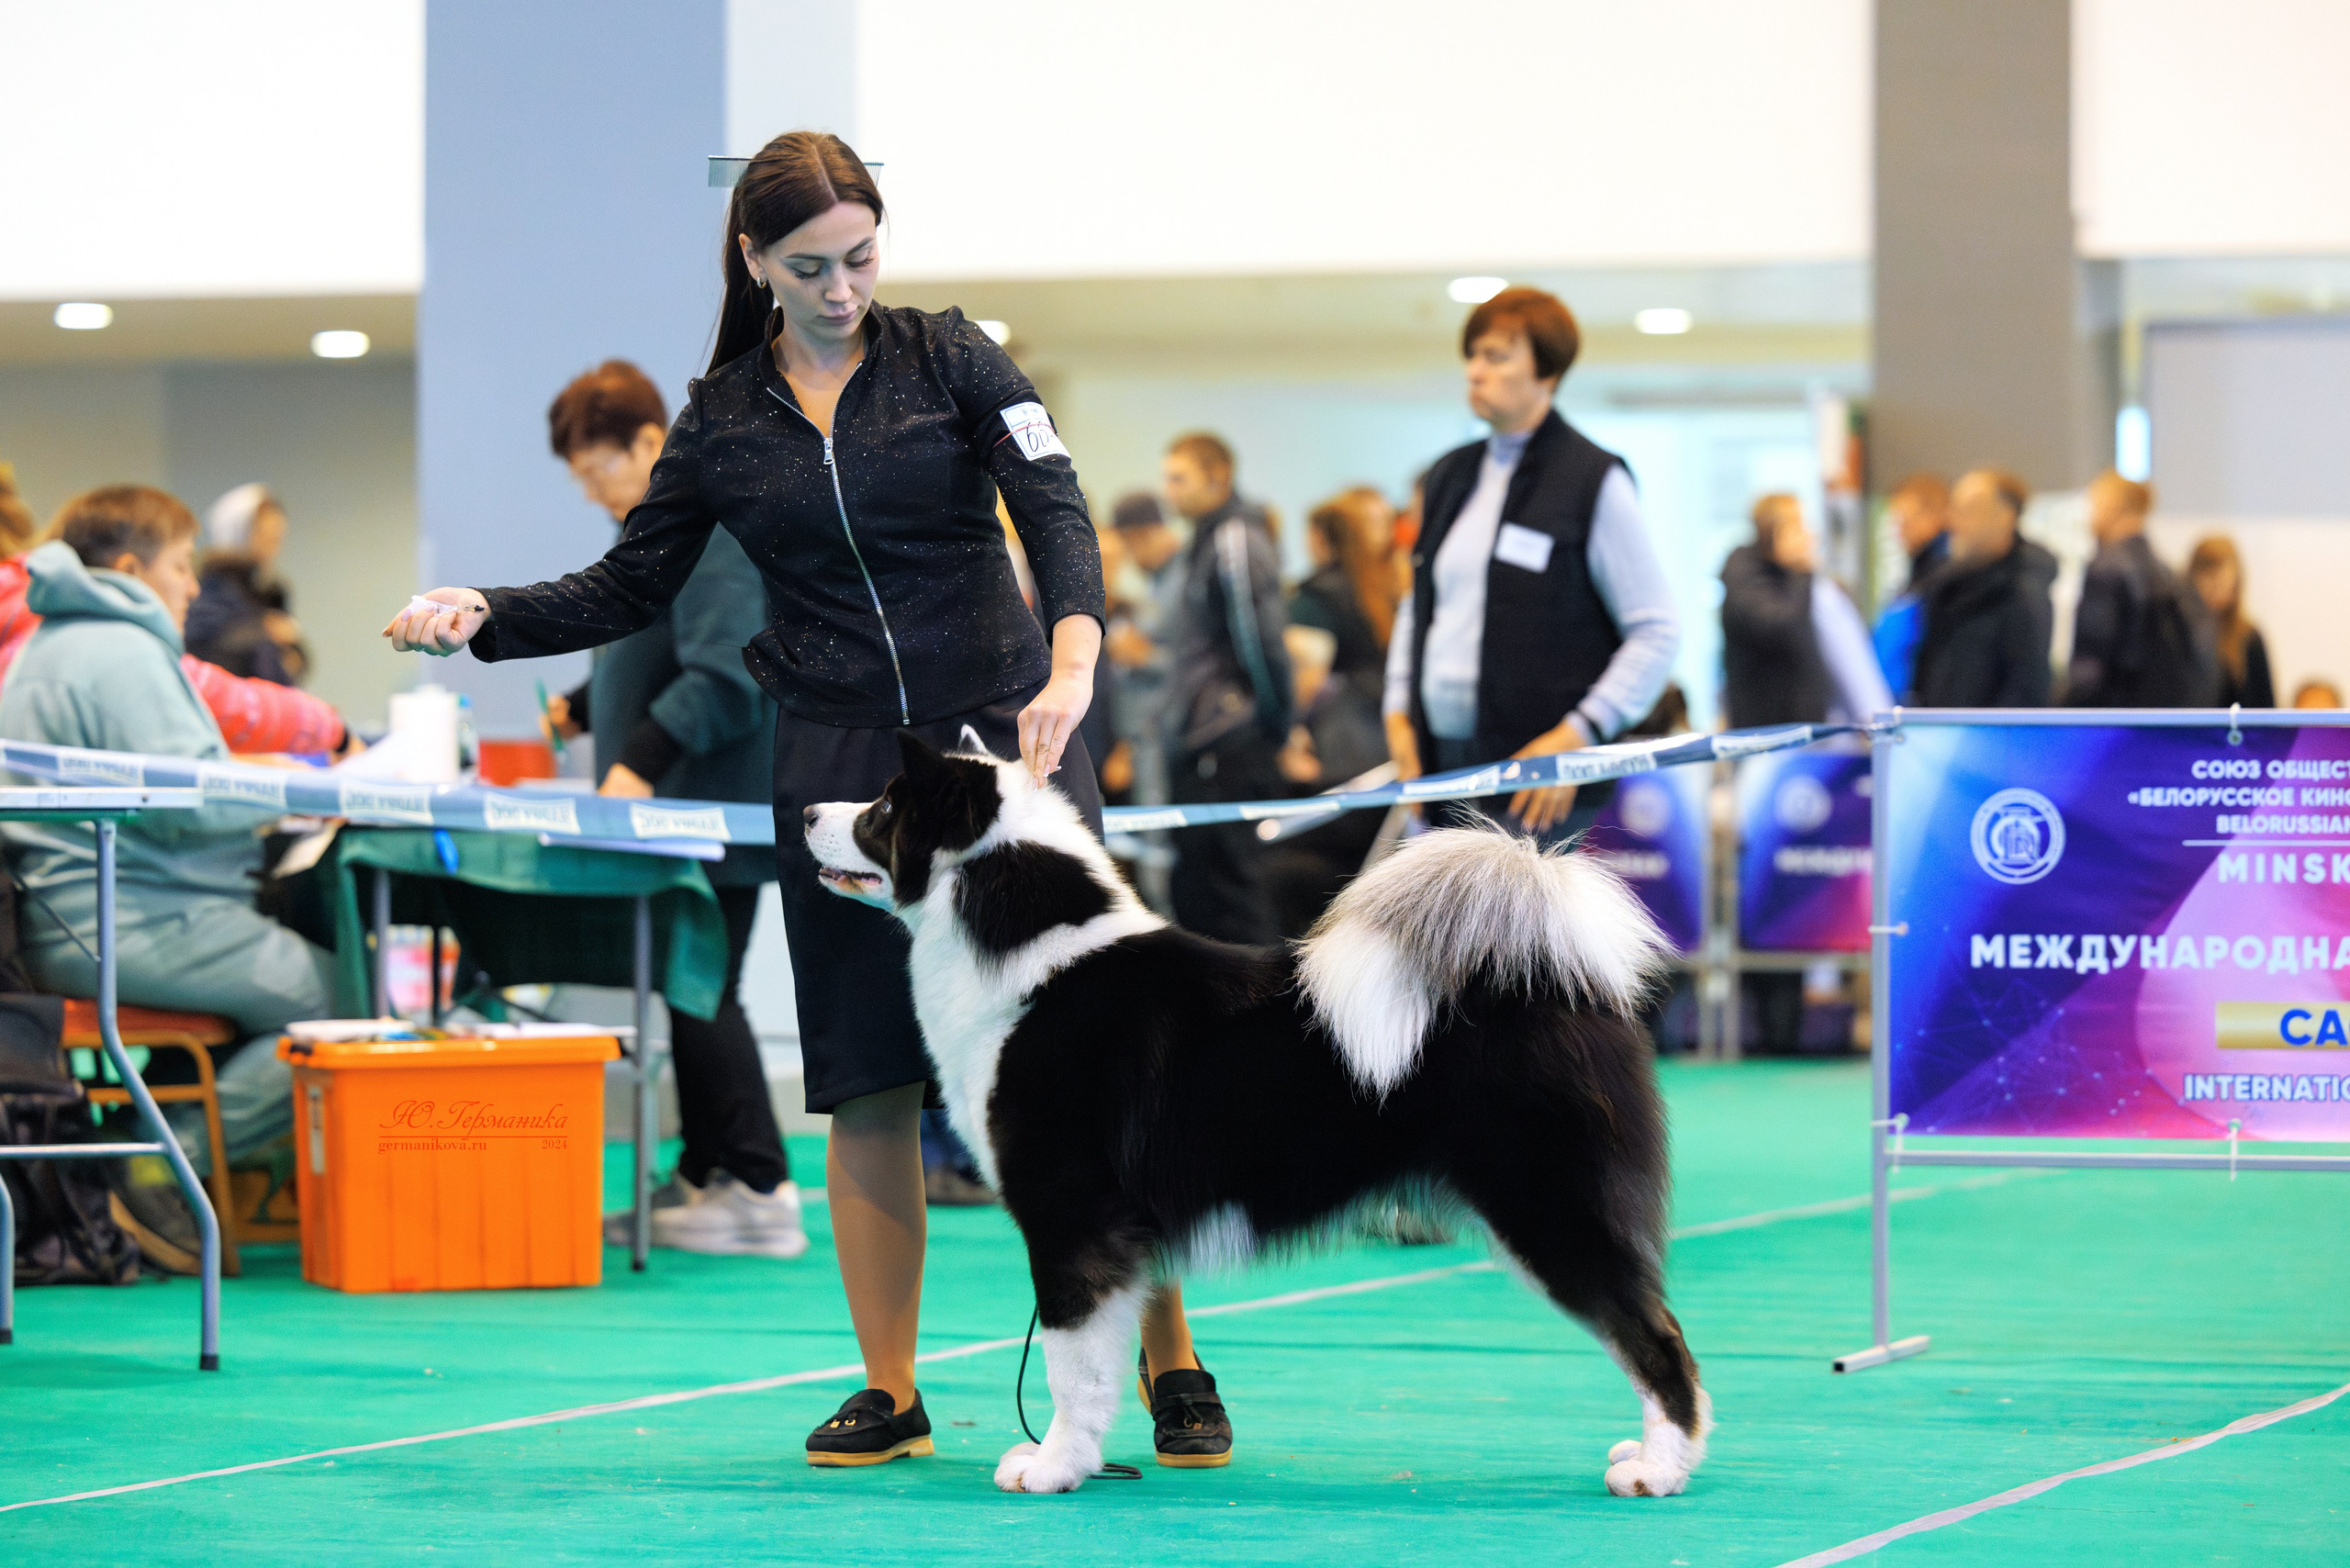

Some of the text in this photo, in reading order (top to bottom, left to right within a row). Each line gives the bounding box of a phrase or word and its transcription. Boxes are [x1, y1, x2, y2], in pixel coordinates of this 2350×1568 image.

[2191, 759, 2262, 780] СОЮЗ
[2218, 853, 2350, 884] MINSK
[1971, 934, 2350, 975] МЕЖДУНАРОДНА
[2280, 1008, 2350, 1046] CA
